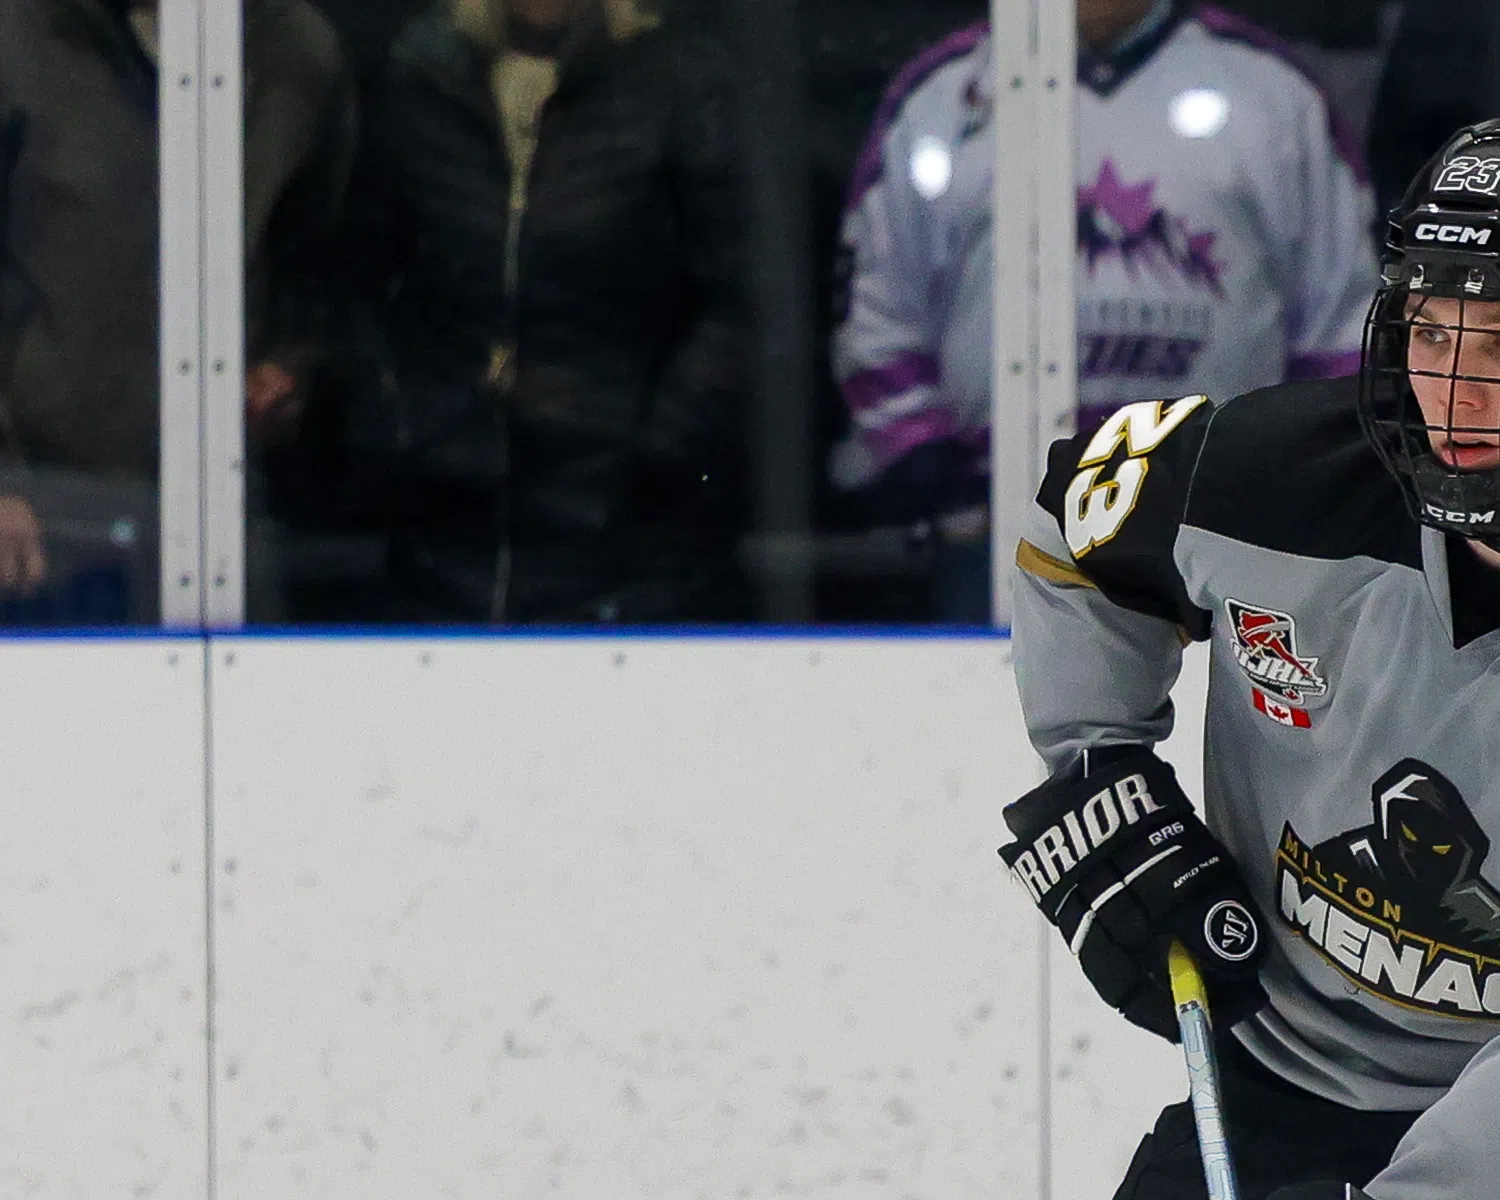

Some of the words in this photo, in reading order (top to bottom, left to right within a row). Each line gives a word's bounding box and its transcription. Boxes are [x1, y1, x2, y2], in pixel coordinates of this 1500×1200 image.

[1415, 223, 1491, 245] CCM
[1065, 394, 1208, 560] 23
[1426, 503, 1496, 524] CCM
[1012, 773, 1168, 903] RRIOR
[1285, 831, 1402, 923] MILTON
